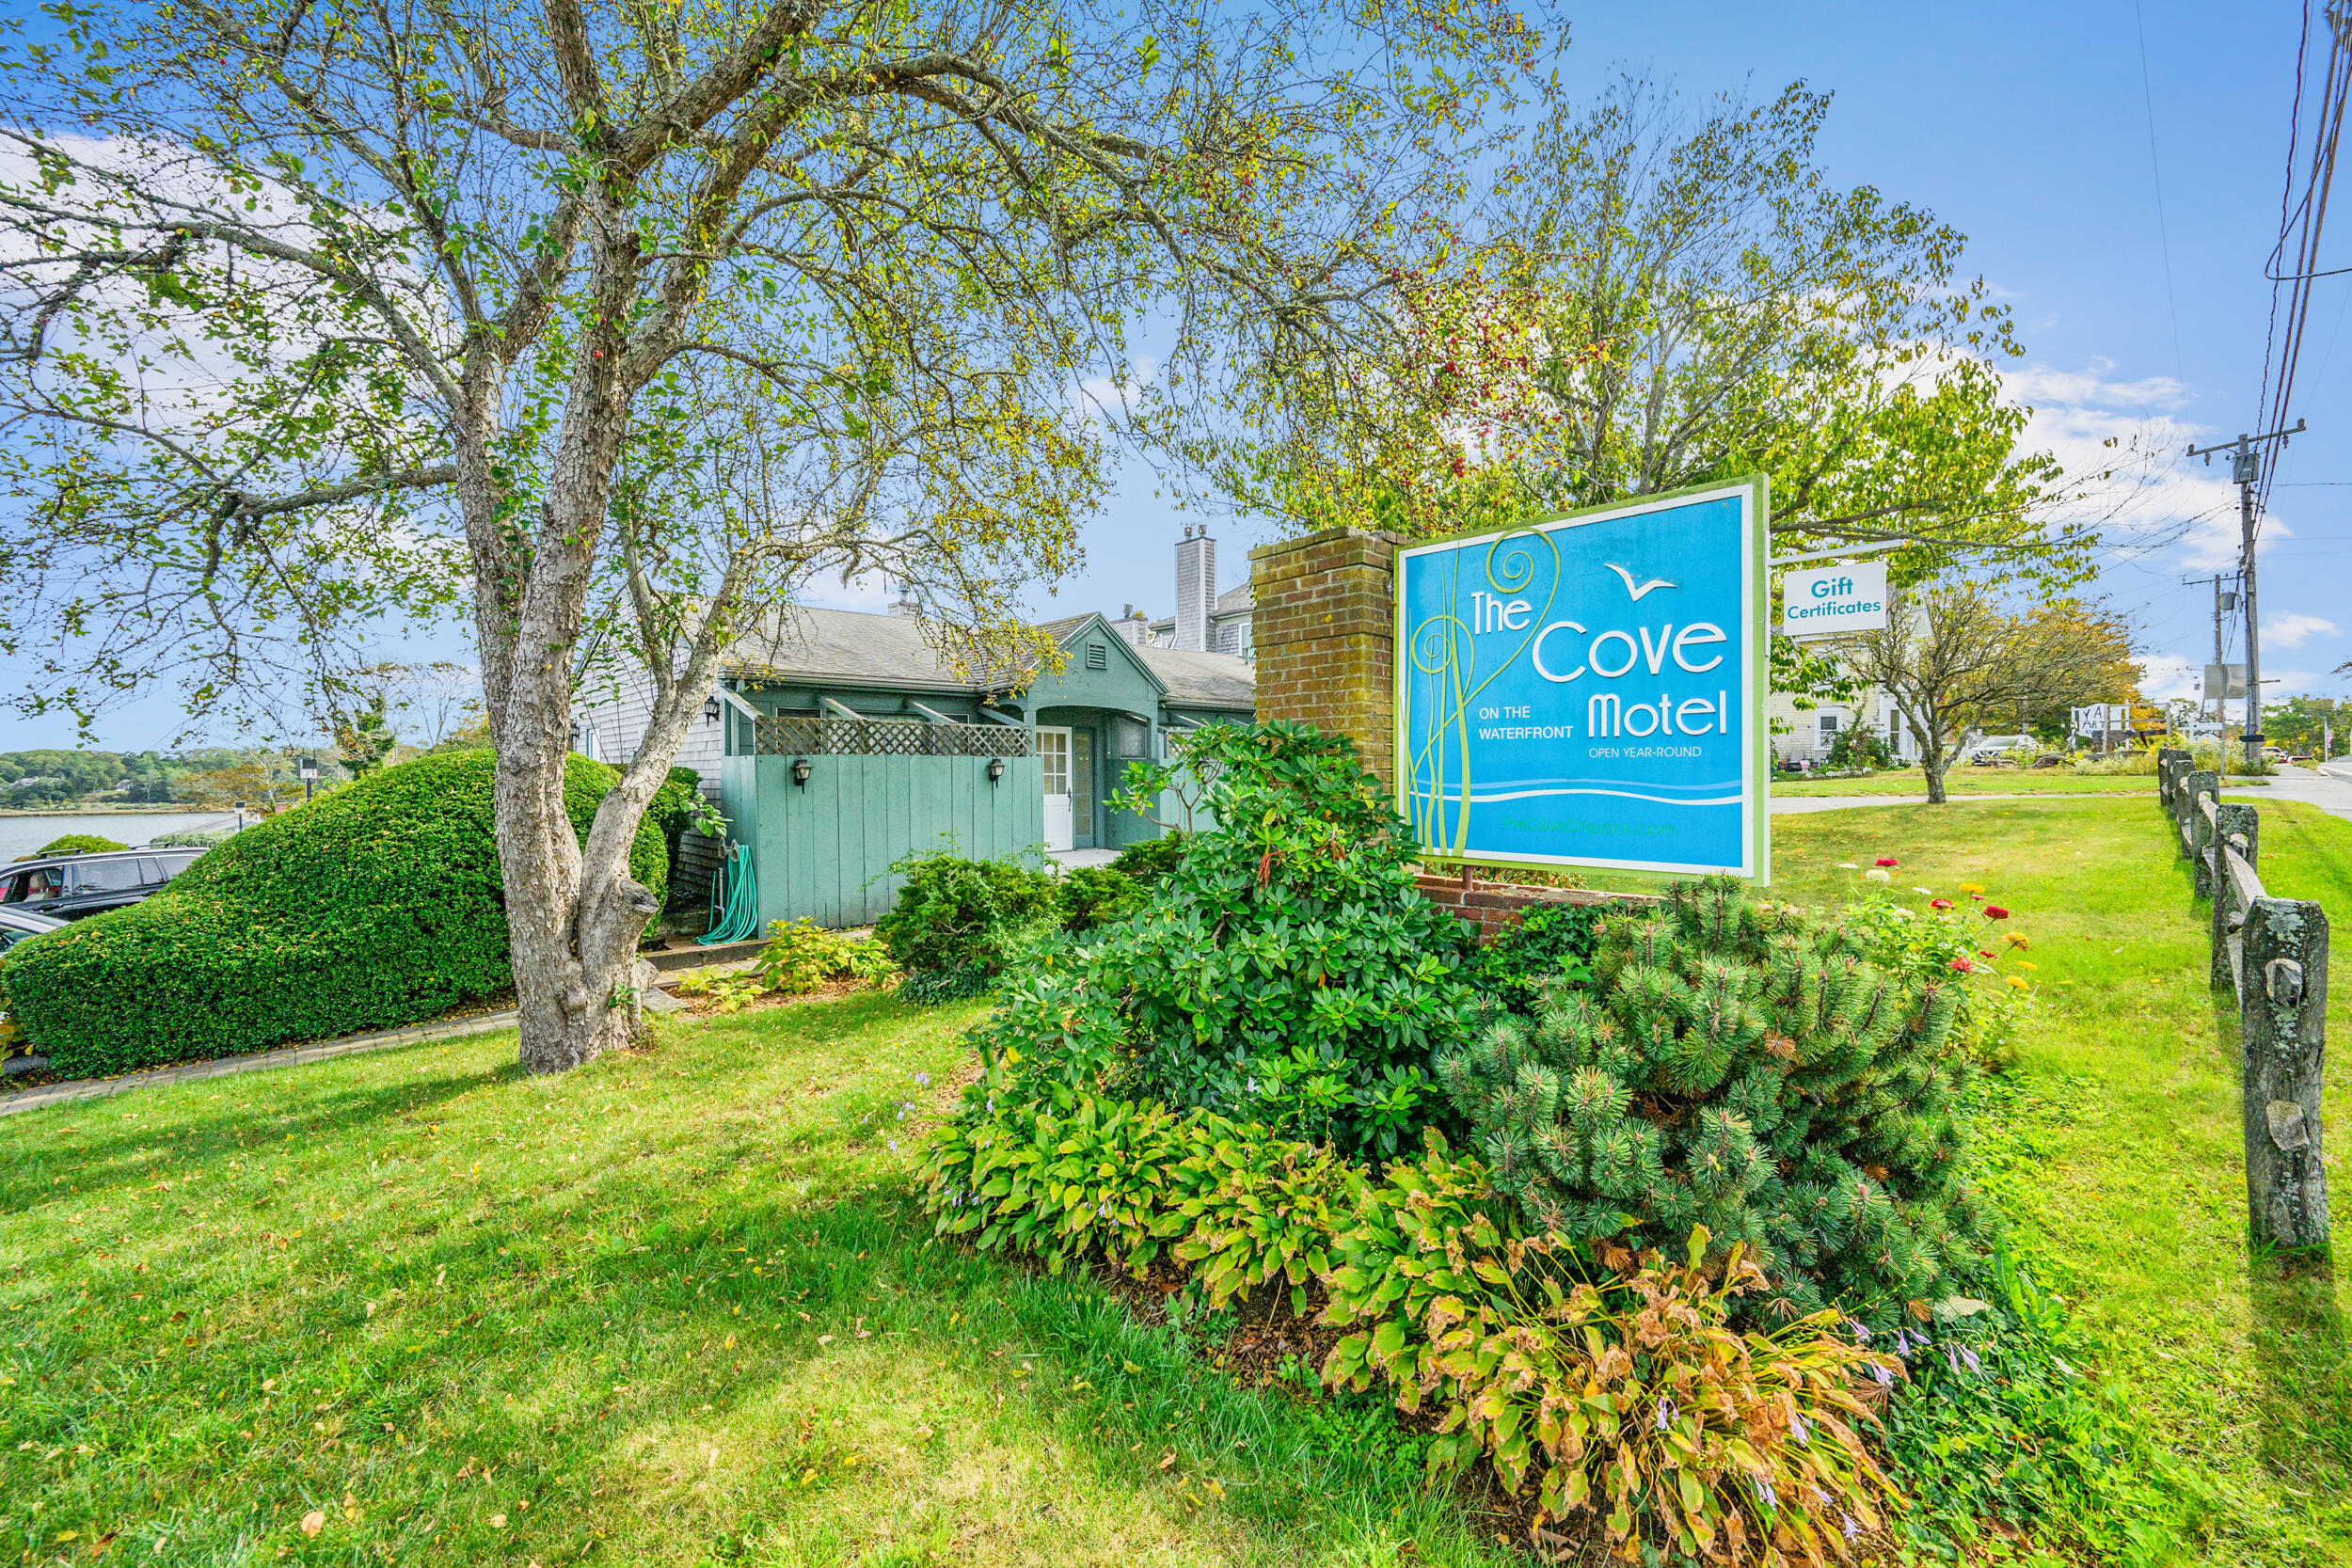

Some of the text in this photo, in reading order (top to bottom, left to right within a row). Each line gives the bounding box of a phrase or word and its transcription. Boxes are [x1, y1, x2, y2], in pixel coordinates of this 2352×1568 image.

[1811, 577, 1853, 598] Gift
[1470, 591, 1532, 635] The
[1788, 601, 1881, 619] Certificates
[1532, 621, 1727, 683] Cove
[1479, 705, 1532, 721] ON THE
[1588, 689, 1727, 738] Motel
[1479, 725, 1574, 740] WATERFRONT
[1588, 746, 1703, 758] OPEN YEAR-ROUND
